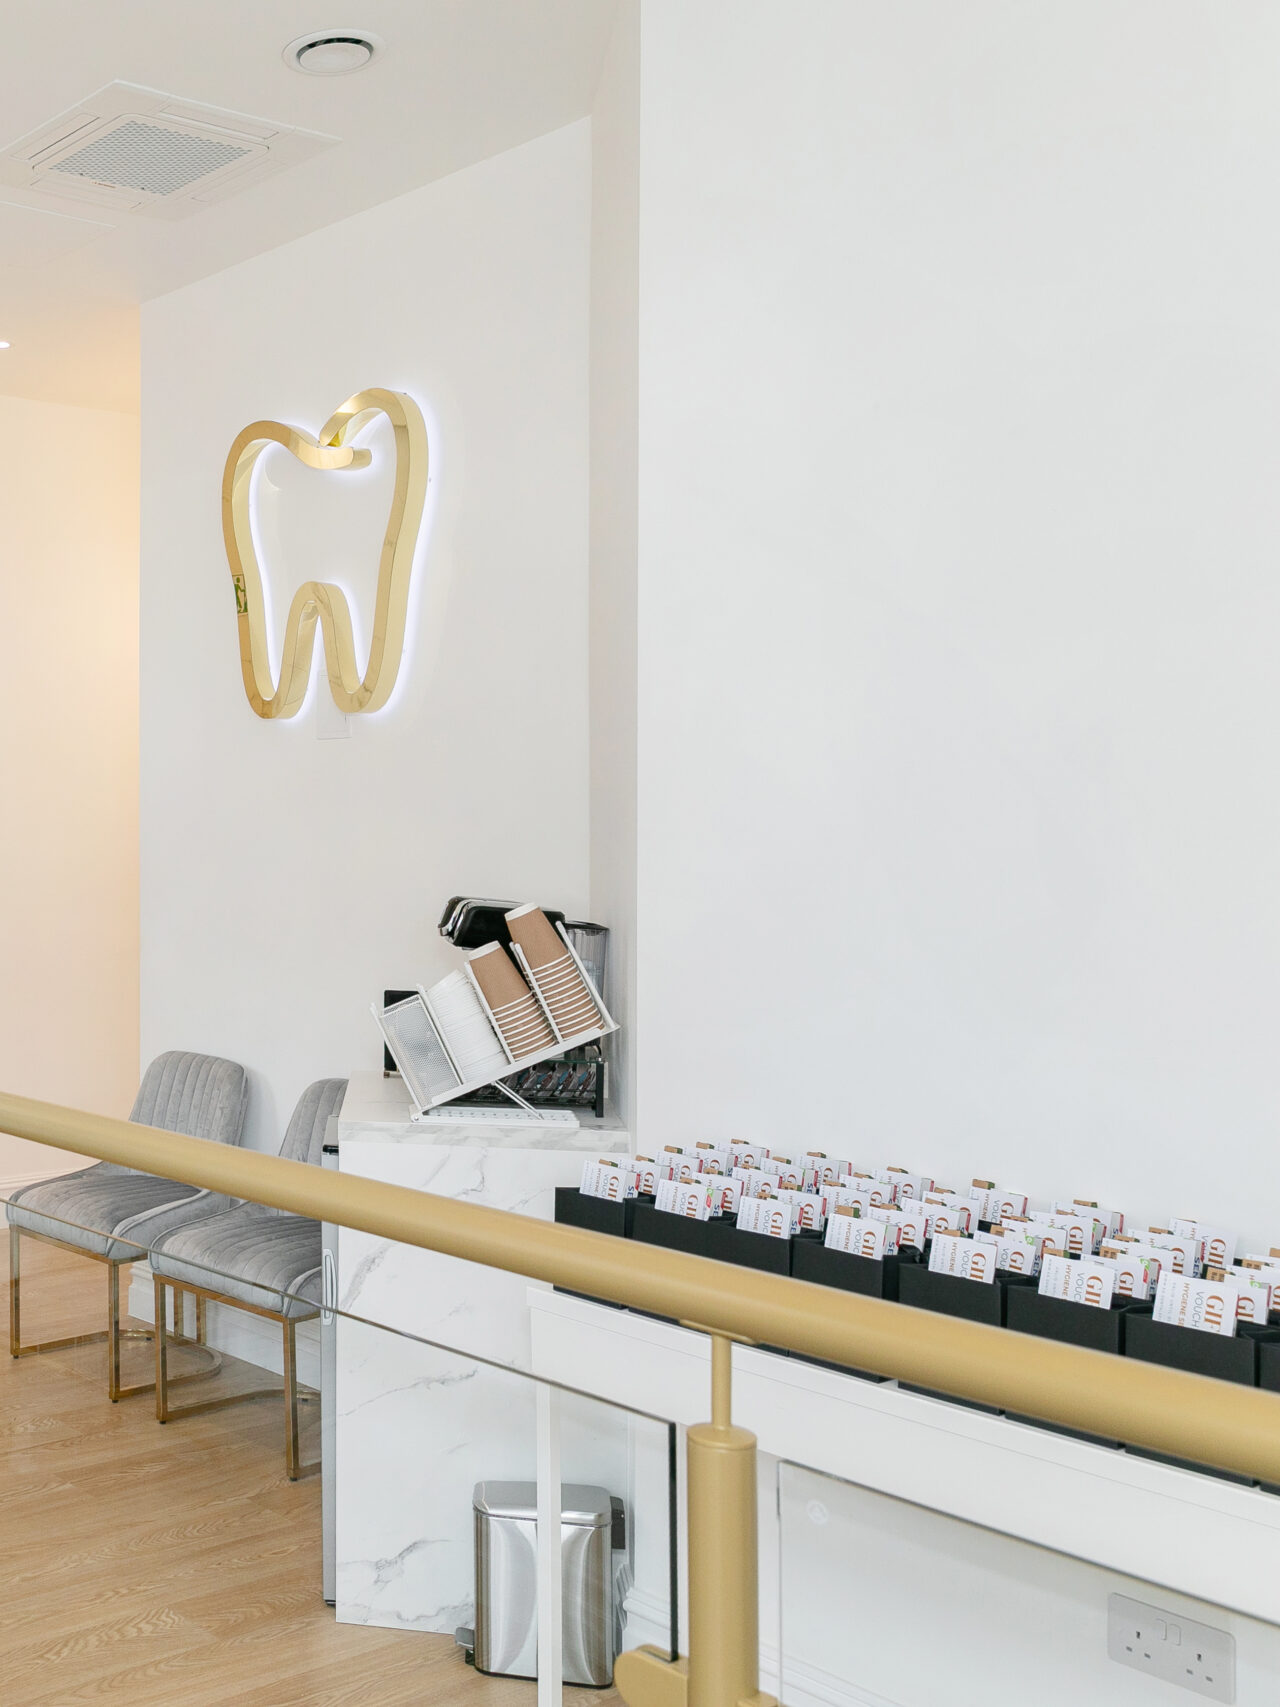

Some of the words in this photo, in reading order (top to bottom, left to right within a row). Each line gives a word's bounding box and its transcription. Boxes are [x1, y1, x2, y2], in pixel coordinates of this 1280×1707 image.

[844, 1222, 852, 1250] HYGIENE
[949, 1242, 958, 1272] HYGIENE
[1062, 1264, 1072, 1296] HYGIENE
[1179, 1282, 1190, 1316] HYGIENE
[1192, 1291, 1204, 1328] VOUCH
